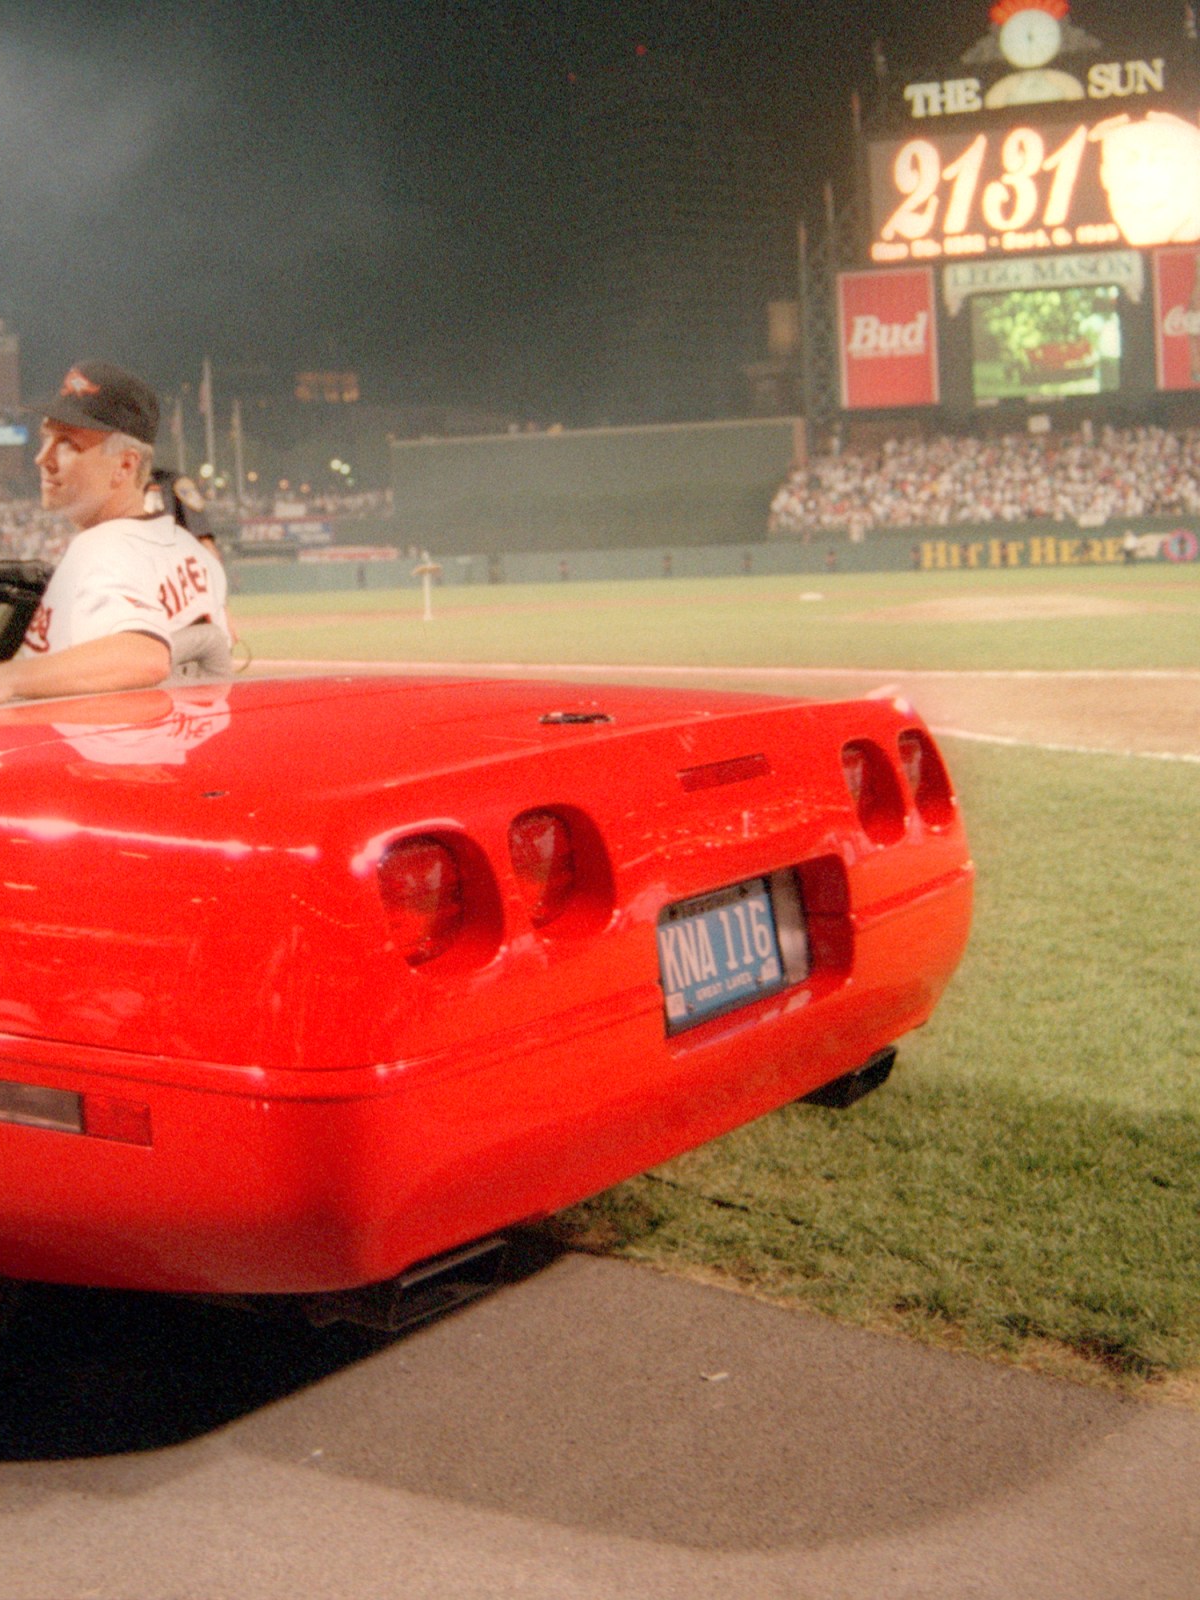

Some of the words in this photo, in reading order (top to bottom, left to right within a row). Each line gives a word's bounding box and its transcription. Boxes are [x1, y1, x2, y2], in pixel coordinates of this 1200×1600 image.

[904, 78, 982, 118] THE
[1087, 58, 1165, 99] SUN
[880, 124, 1088, 242] 2131
[848, 311, 927, 355] Bud
[659, 918, 718, 993] KNA
[719, 900, 772, 971] 116
